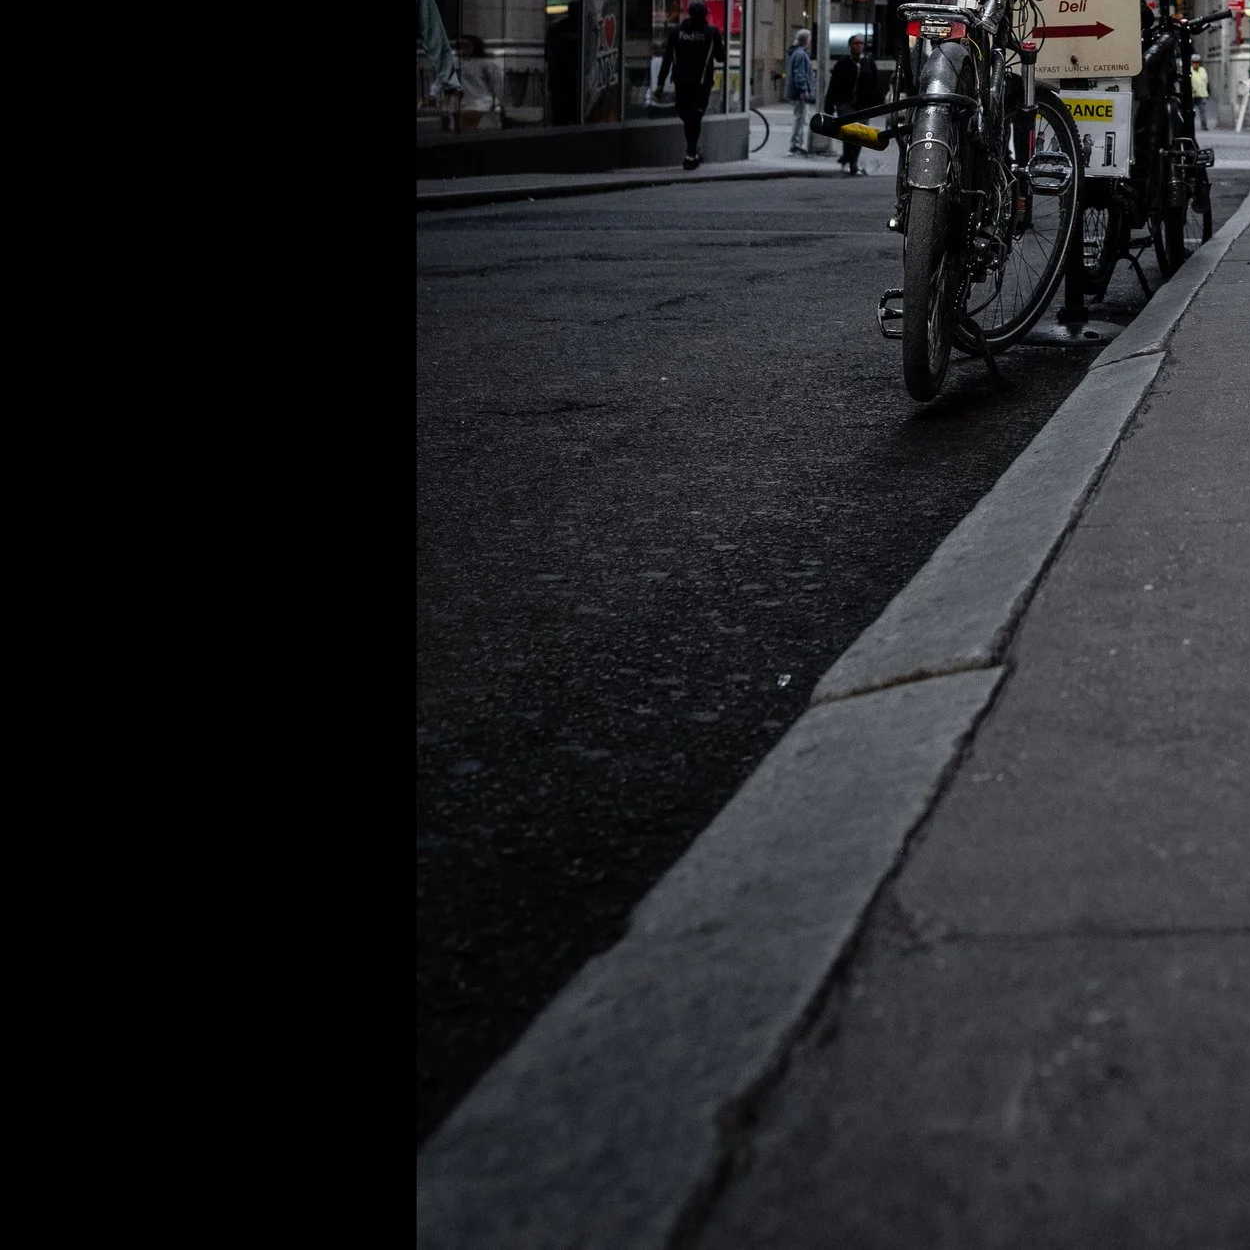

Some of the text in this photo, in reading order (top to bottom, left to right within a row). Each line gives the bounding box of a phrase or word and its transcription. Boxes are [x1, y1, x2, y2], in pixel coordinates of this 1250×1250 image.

[1058, 0, 1087, 13] Deli
[1036, 65, 1060, 73] AKFAST
[1093, 63, 1130, 71] CATERING
[1064, 103, 1113, 118] RANCE
